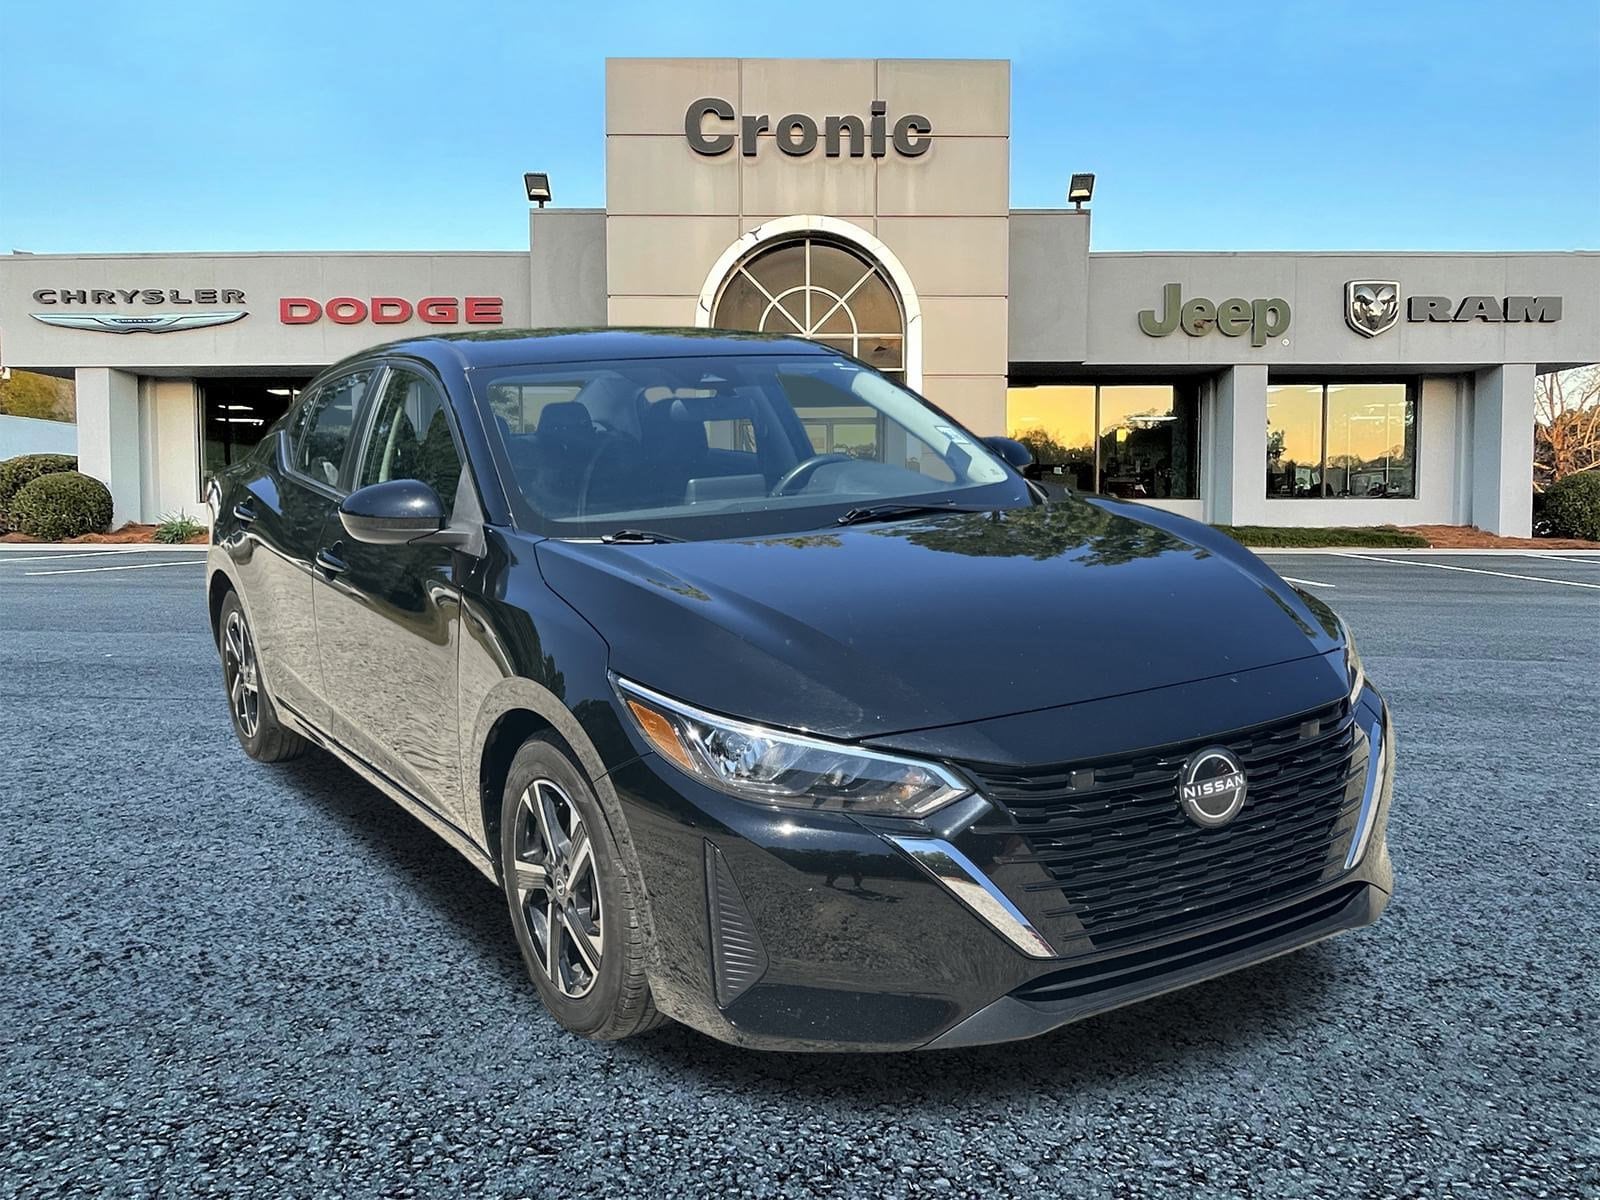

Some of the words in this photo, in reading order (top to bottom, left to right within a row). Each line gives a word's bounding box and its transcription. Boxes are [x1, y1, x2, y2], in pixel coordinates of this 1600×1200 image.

[684, 97, 932, 157] Cronic
[32, 288, 246, 305] CHRYSLER
[1407, 296, 1562, 322] RAM
[280, 297, 504, 324] DODGE
[1138, 283, 1291, 347] Jeep
[1183, 773, 1244, 799] NISSAN
